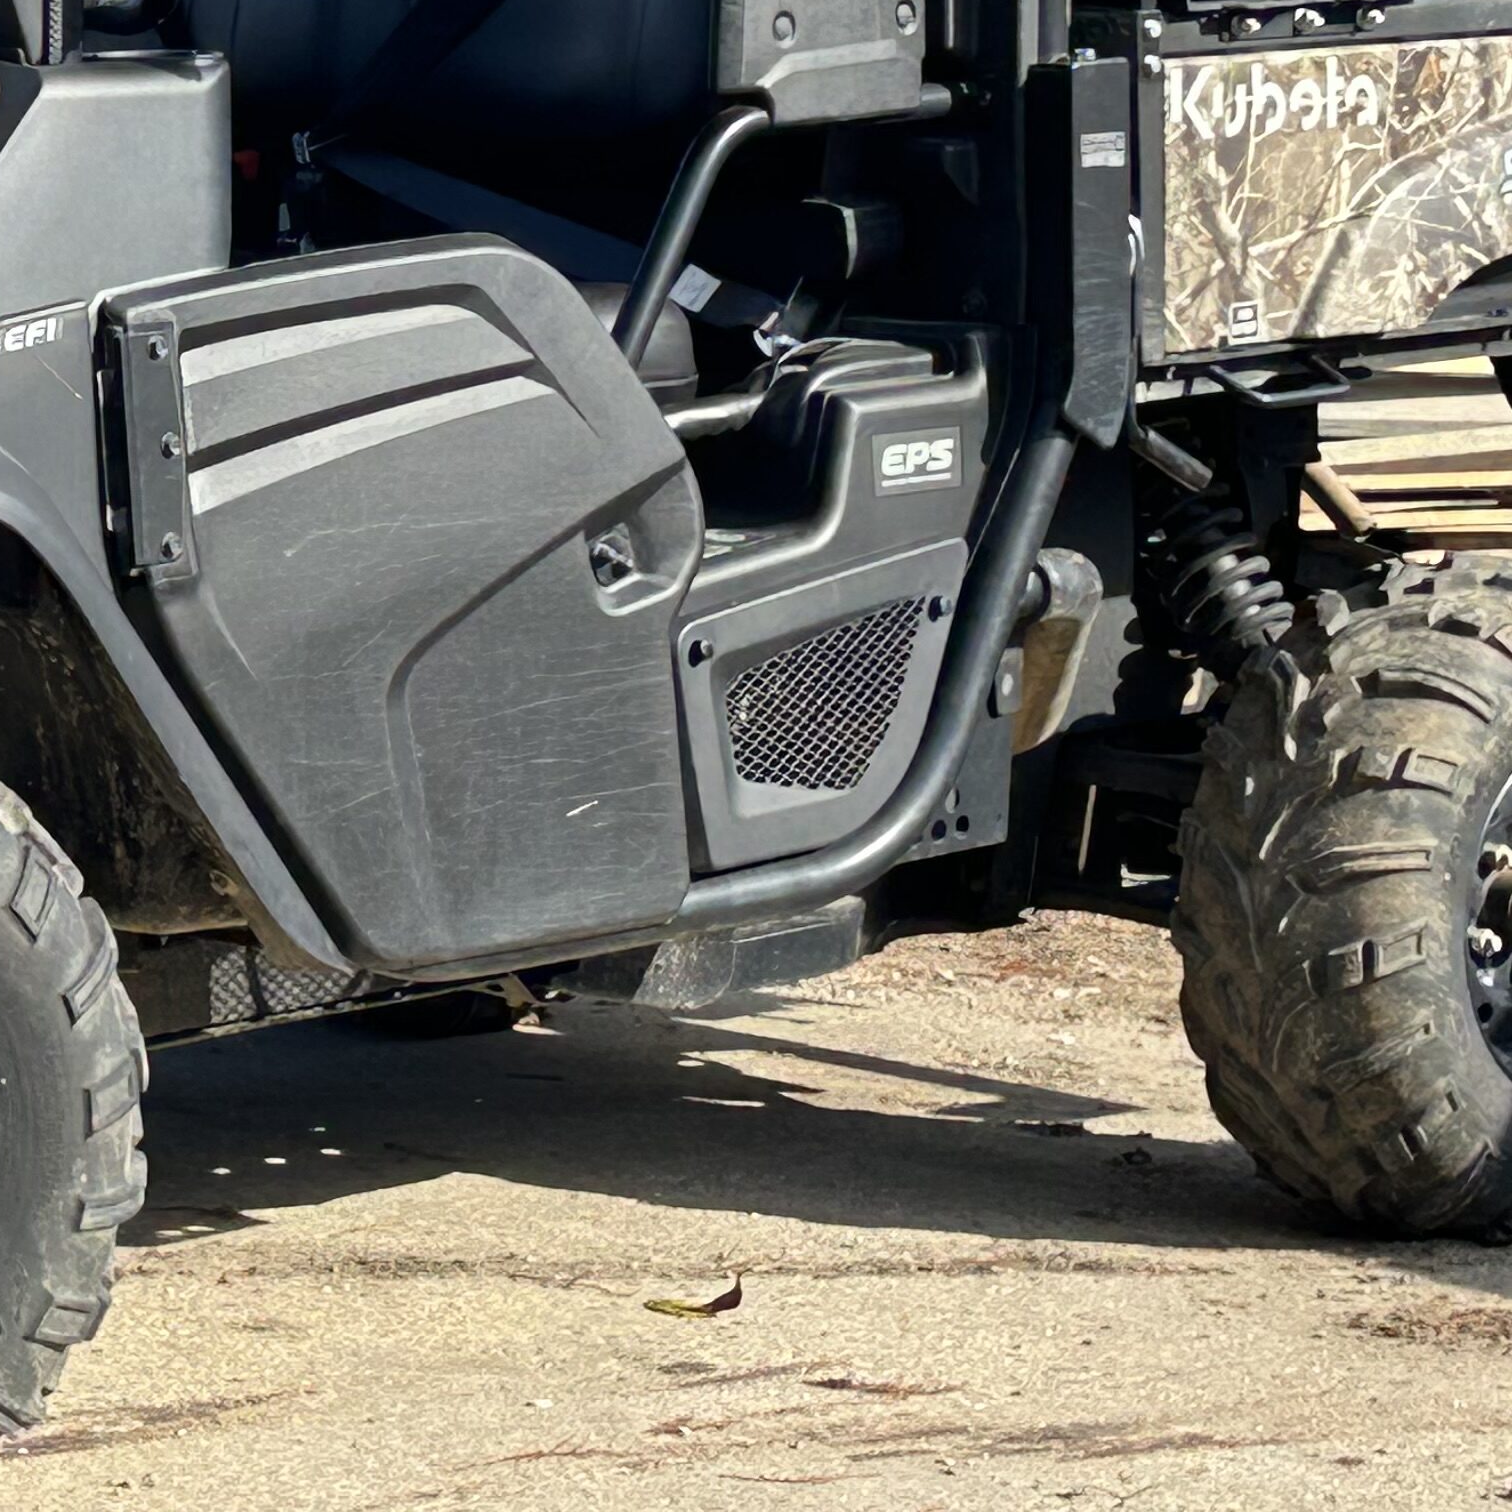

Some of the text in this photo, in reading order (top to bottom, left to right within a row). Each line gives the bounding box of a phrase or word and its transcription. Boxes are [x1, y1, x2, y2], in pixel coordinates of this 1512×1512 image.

[1169, 54, 1379, 140] Kubota
[3, 316, 57, 353] EFI
[880, 438, 955, 476] EPS
